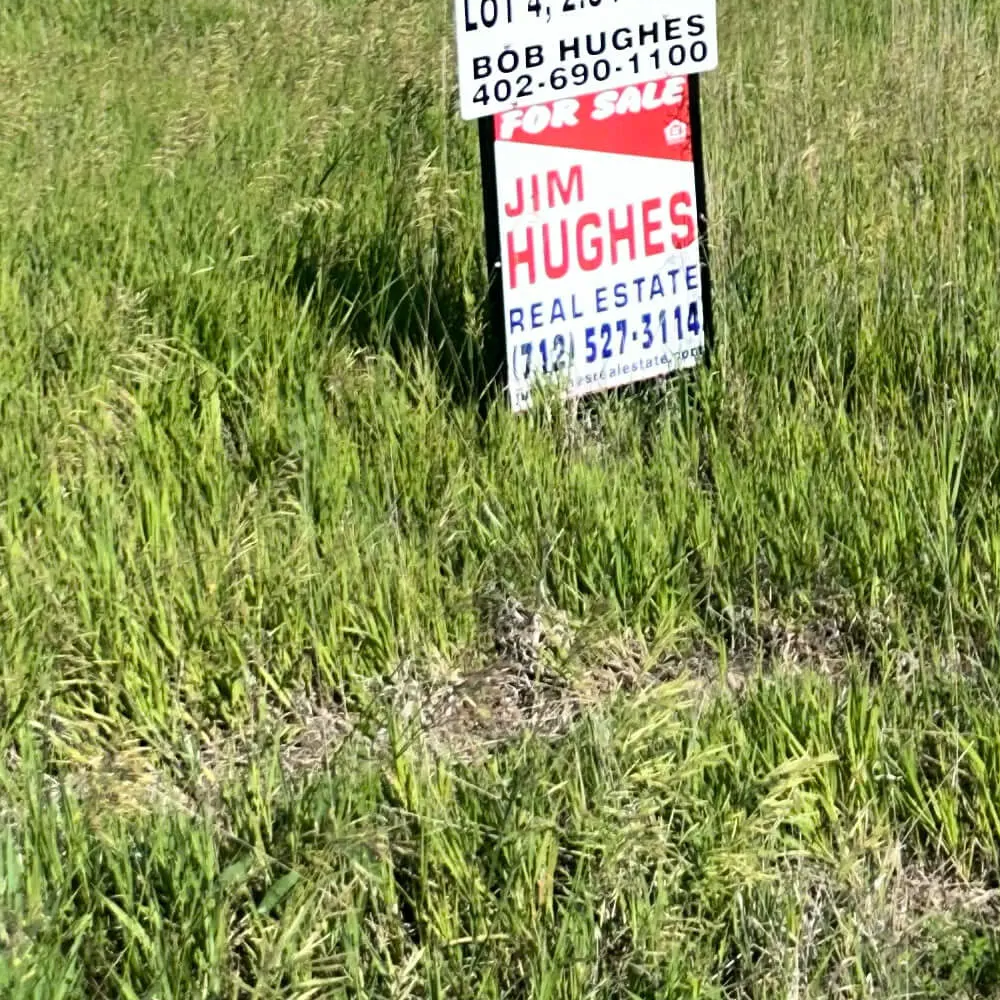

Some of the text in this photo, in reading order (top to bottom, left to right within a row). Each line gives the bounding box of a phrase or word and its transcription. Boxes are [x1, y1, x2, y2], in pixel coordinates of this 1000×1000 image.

[472, 14, 706, 80] BOB HUGHES
[472, 40, 708, 106] 402-690-1100
[499, 78, 686, 140] FOR SALE
[504, 164, 584, 218] JIM
[507, 191, 696, 289] HUGHES
[509, 265, 699, 334] REAL ESTATE
[513, 332, 575, 381] (712)
